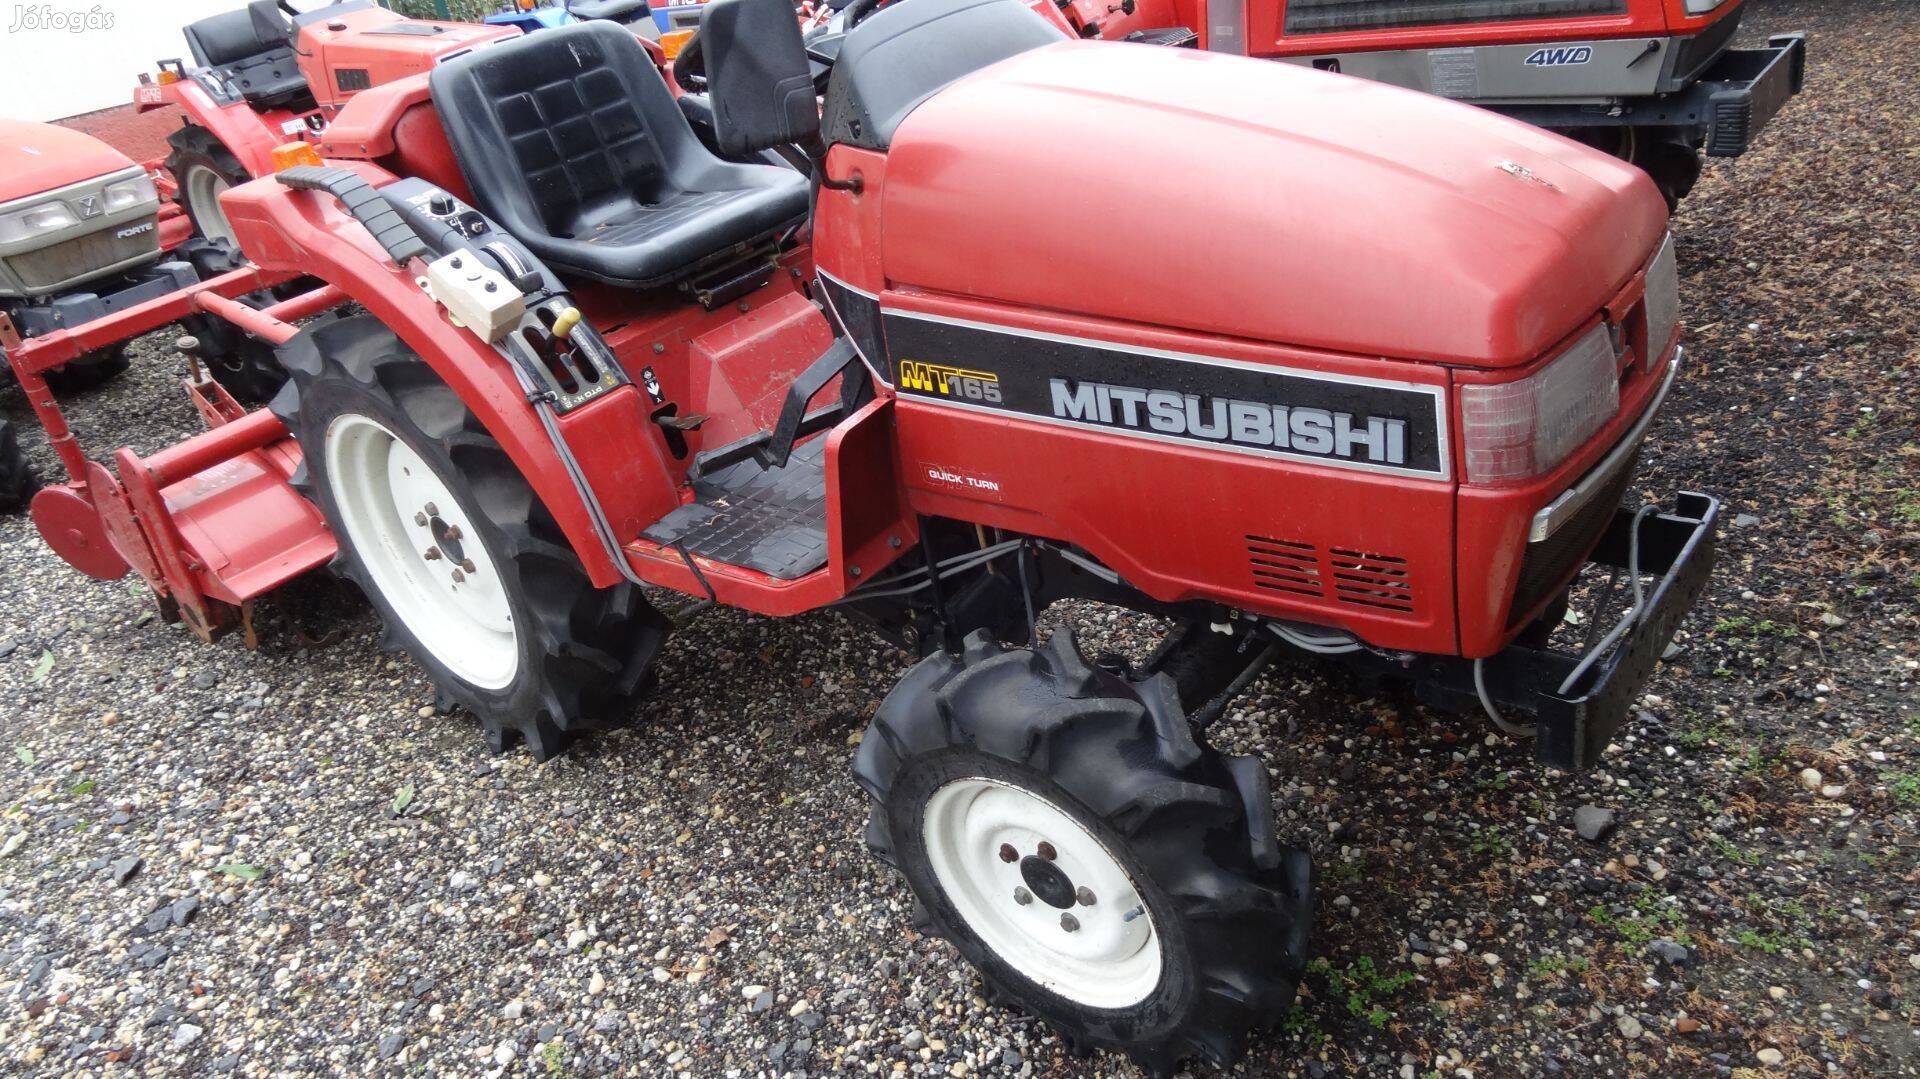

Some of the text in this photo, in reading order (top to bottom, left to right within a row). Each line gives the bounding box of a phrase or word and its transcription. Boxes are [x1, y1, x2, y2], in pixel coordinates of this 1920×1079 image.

[1524, 45, 1593, 67] 4WD
[116, 222, 154, 239] FORTE
[1050, 378, 1407, 464] MITSUBISHI
[928, 469, 1000, 491] QUICK TURN
